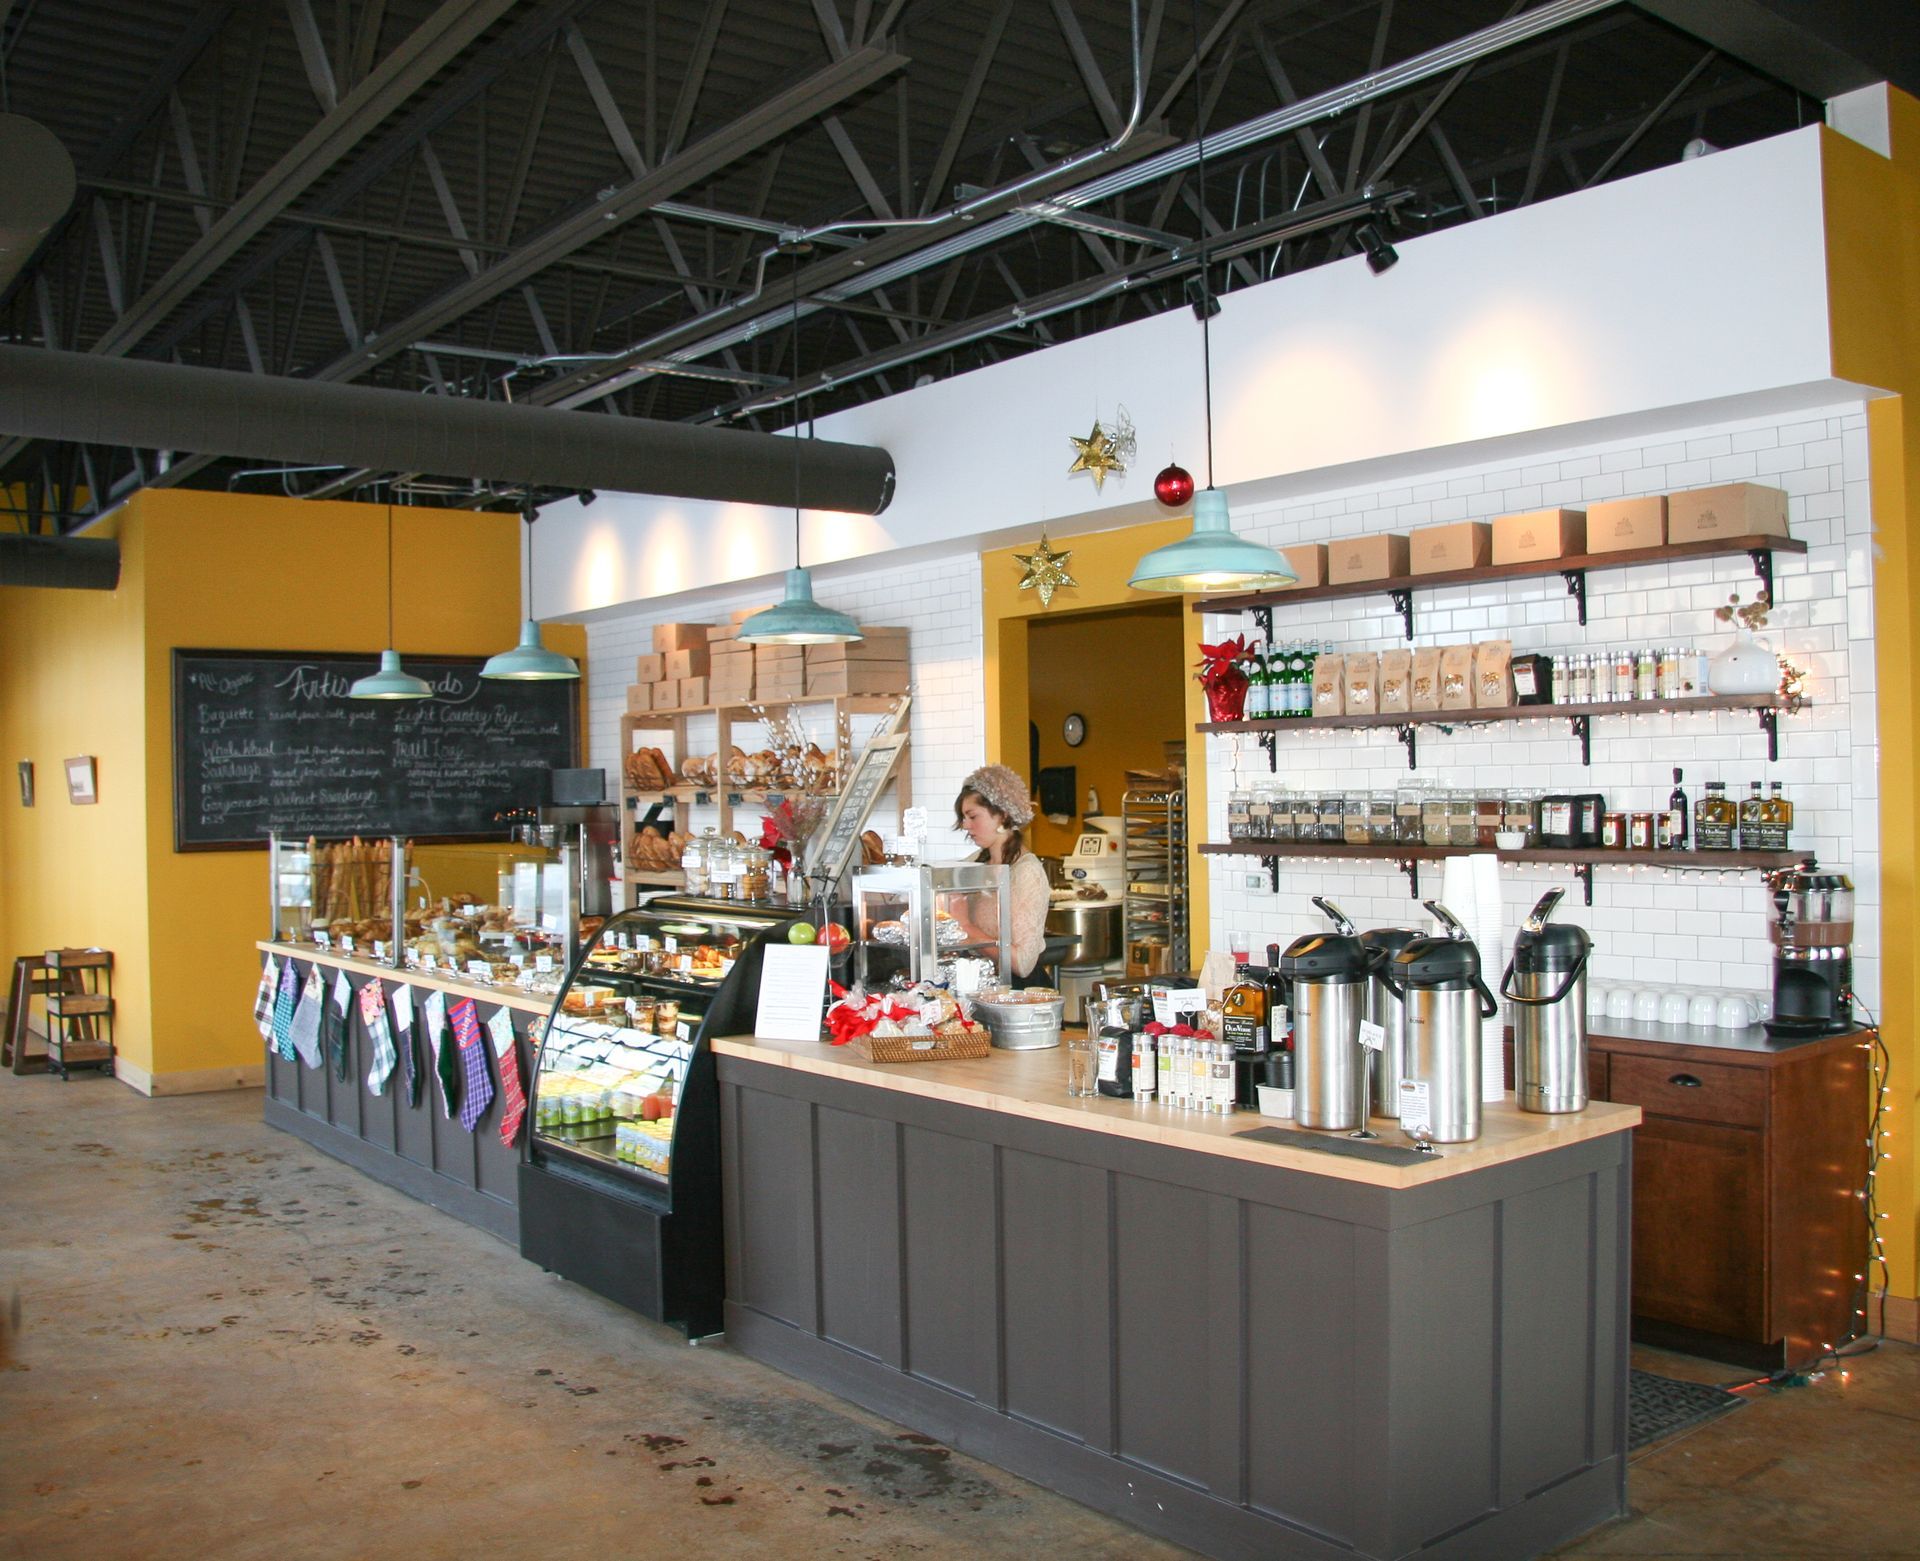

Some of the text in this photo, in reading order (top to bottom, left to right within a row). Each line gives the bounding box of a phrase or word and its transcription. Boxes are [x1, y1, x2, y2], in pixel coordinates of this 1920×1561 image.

[275, 665, 463, 701] Artis ads
[198, 703, 255, 729] Baguette
[440, 705, 488, 728] Country
[201, 760, 262, 782] Sourdough
